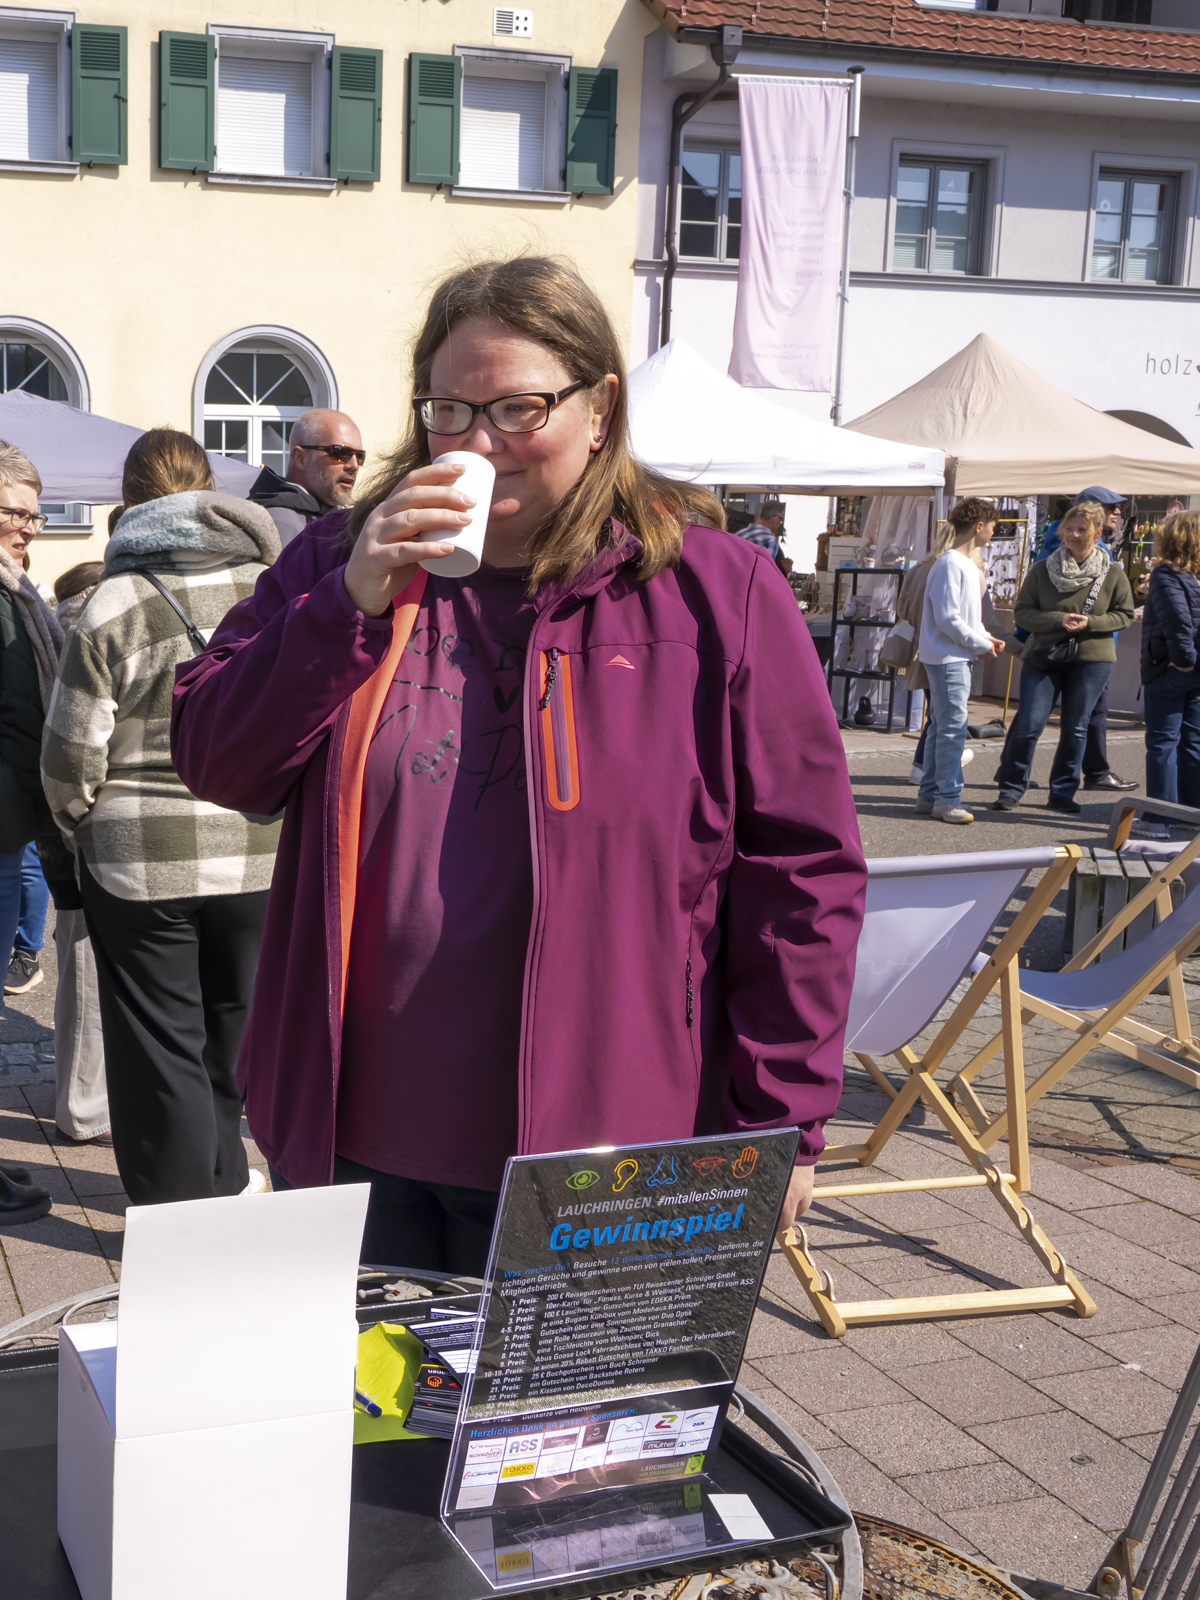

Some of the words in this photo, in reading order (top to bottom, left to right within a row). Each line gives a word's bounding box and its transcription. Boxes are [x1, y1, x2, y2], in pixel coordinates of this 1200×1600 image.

[556, 1196, 652, 1217] LAUCHRINGEN
[658, 1188, 748, 1206] #mitallenSinnen
[550, 1204, 745, 1252] Gewinnspiel
[573, 1259, 607, 1268] Besuche
[717, 1243, 749, 1251] benenne
[502, 1278, 536, 1286] richtigen
[537, 1272, 571, 1282] Gerüche
[572, 1269, 587, 1277] und
[588, 1267, 621, 1277] gewinne
[732, 1250, 762, 1258] unserer
[500, 1282, 568, 1296] Mitgliedsbetriebe.
[565, 1287, 616, 1298] Reisegutschein
[546, 1300, 580, 1309] 10er-Karte
[650, 1295, 674, 1304] EDEKA
[540, 1327, 573, 1336] Gutschein
[606, 1316, 647, 1326] Sonnenbrille
[675, 1310, 693, 1318] Optik
[565, 1315, 589, 1324] Bugatti
[632, 1306, 667, 1314] Modehaus
[572, 1331, 605, 1340] Naturzaun
[620, 1324, 652, 1333] Zaunteam
[653, 1320, 688, 1329] Granacher
[552, 1340, 594, 1350] Tischleuchte
[592, 1343, 642, 1354] Fahrradschloss
[694, 1330, 736, 1340] Fahrradladen
[598, 1352, 631, 1361] Gutschein
[645, 1346, 668, 1354] TAKKO
[546, 1366, 595, 1377] Buchgutschein
[627, 1358, 659, 1366] Schreiner
[541, 1377, 575, 1386] Gutschein
[589, 1370, 623, 1379] Backstube
[576, 1380, 615, 1389] DecoDomus
[470, 1426, 519, 1438] Herzlichen
[522, 1422, 545, 1432] Dank
[560, 1417, 589, 1426] unsere
[591, 1408, 637, 1422] Sponsoren:
[509, 1439, 538, 1454] ASS
[641, 1461, 686, 1472] LAUCHRINGEN
